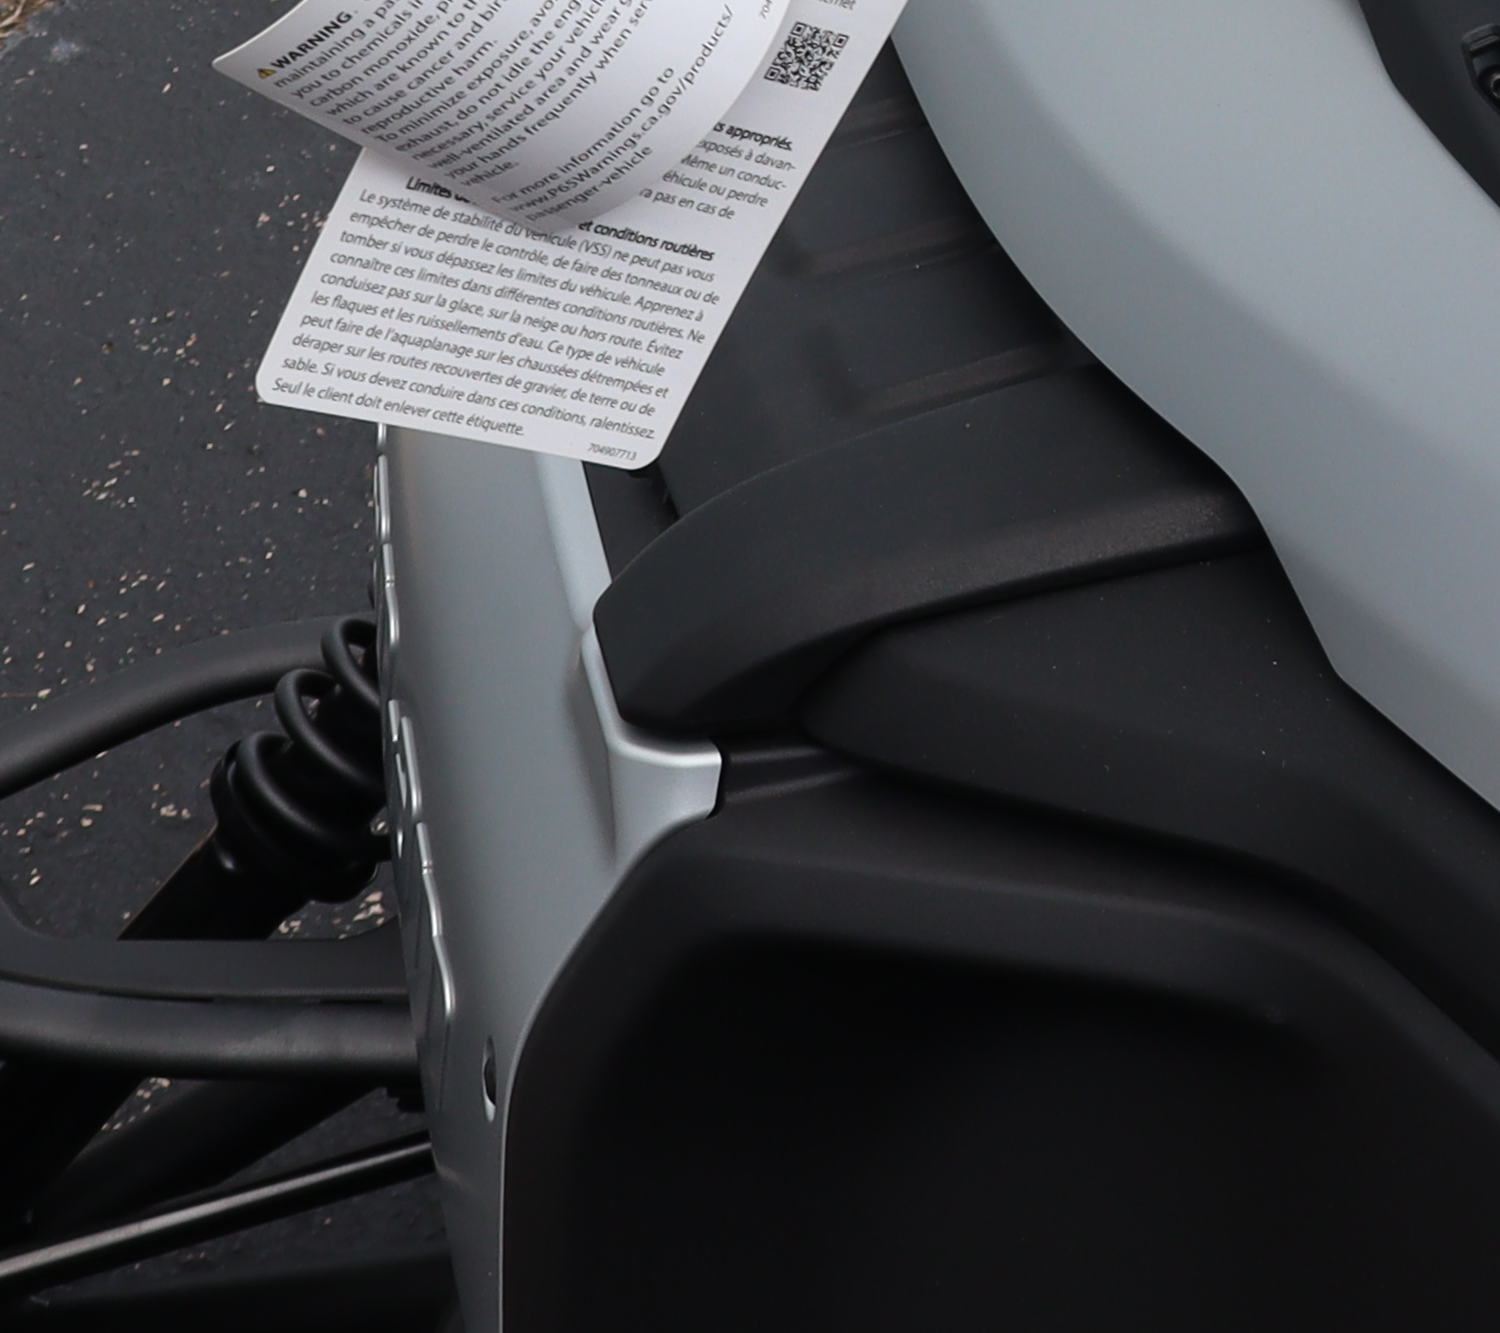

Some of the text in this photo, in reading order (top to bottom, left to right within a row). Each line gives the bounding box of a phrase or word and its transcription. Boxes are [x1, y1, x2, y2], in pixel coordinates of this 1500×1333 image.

[273, 27, 366, 88] maintaining
[362, 18, 376, 29] a
[291, 80, 323, 100] you
[320, 69, 341, 82] to
[341, 9, 413, 70] chemicals
[309, 76, 364, 107] carbon
[362, 14, 441, 77] monoxide,
[326, 90, 375, 116] which
[373, 72, 400, 92] are
[395, 29, 450, 74] known
[446, 12, 466, 29] to
[342, 115, 363, 125] to
[362, 89, 407, 117] cause
[406, 50, 455, 91] cancer
[454, 20, 484, 51] and
[361, 40, 498, 135] reproductive harm.
[375, 132, 399, 143] To
[398, 90, 467, 135] minimize
[466, 29, 535, 91] exposure,
[429, 103, 534, 169] well-ventilated
[534, 76, 567, 105] area
[565, 44, 593, 77] and
[589, 6, 621, 45] wear
[456, 104, 479, 121] do
[477, 82, 506, 105] not
[501, 56, 533, 83] idle
[528, 30, 556, 56] the
[412, 120, 489, 160] necessary,
[485, 79, 536, 122] service
[533, 45, 567, 82] your
[446, 161, 479, 179] your
[476, 134, 527, 164] hands
[523, 70, 598, 136] frequently
[594, 28, 633, 70] when
[519, 172, 560, 195] more
[556, 107, 642, 174] information
[640, 85, 660, 107] go
[656, 67, 675, 85] to
[725, 125, 793, 152] appropriés.
[405, 175, 453, 199] Limites
[525, 146, 653, 222] passenger-vehicle
[339, 230, 704, 323] tomber si vous dépassez les limites du véhicule. Apprenez à
[577, 220, 716, 262] et conditions routières
[329, 252, 706, 344] connaître ces limites dans différentes conditions routières. Ne
[271, 377, 525, 437] Seul le client doit enlever cette étiquette.
[587, 442, 638, 462] 704907713
